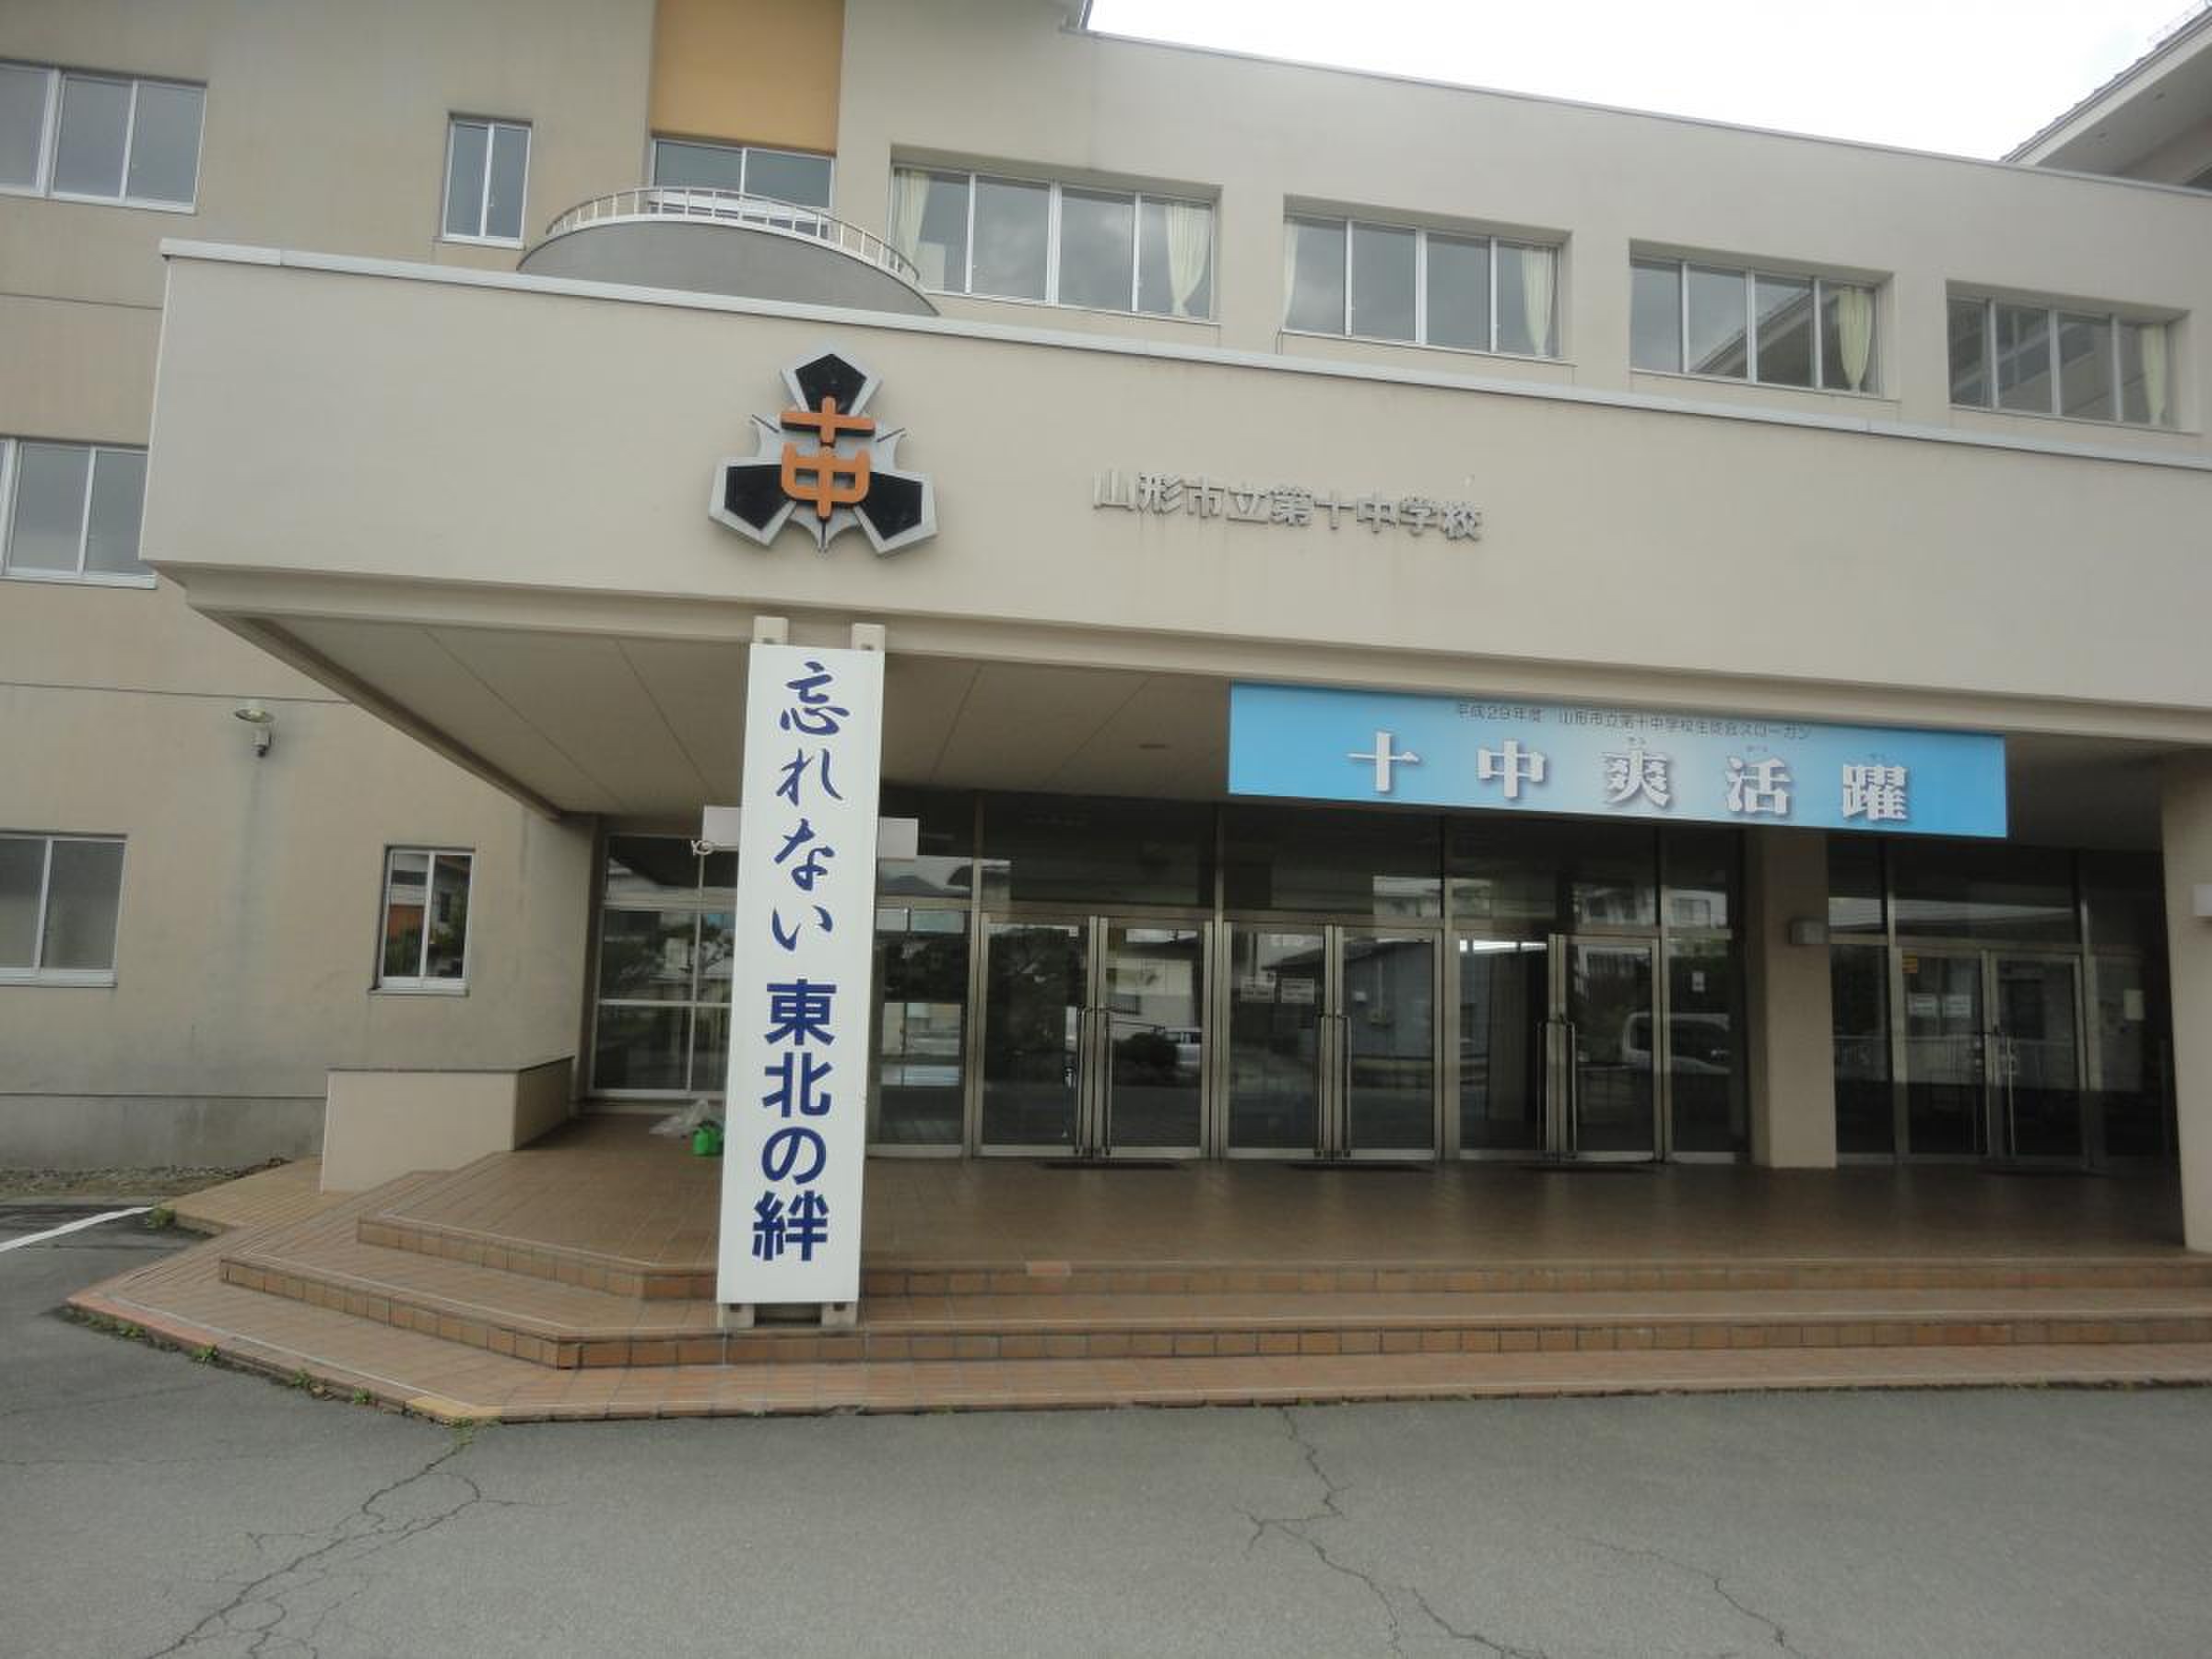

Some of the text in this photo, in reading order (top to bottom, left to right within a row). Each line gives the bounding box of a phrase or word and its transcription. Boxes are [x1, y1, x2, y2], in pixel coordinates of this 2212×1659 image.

[1092, 468, 1484, 542] 山形市立第十中学校
